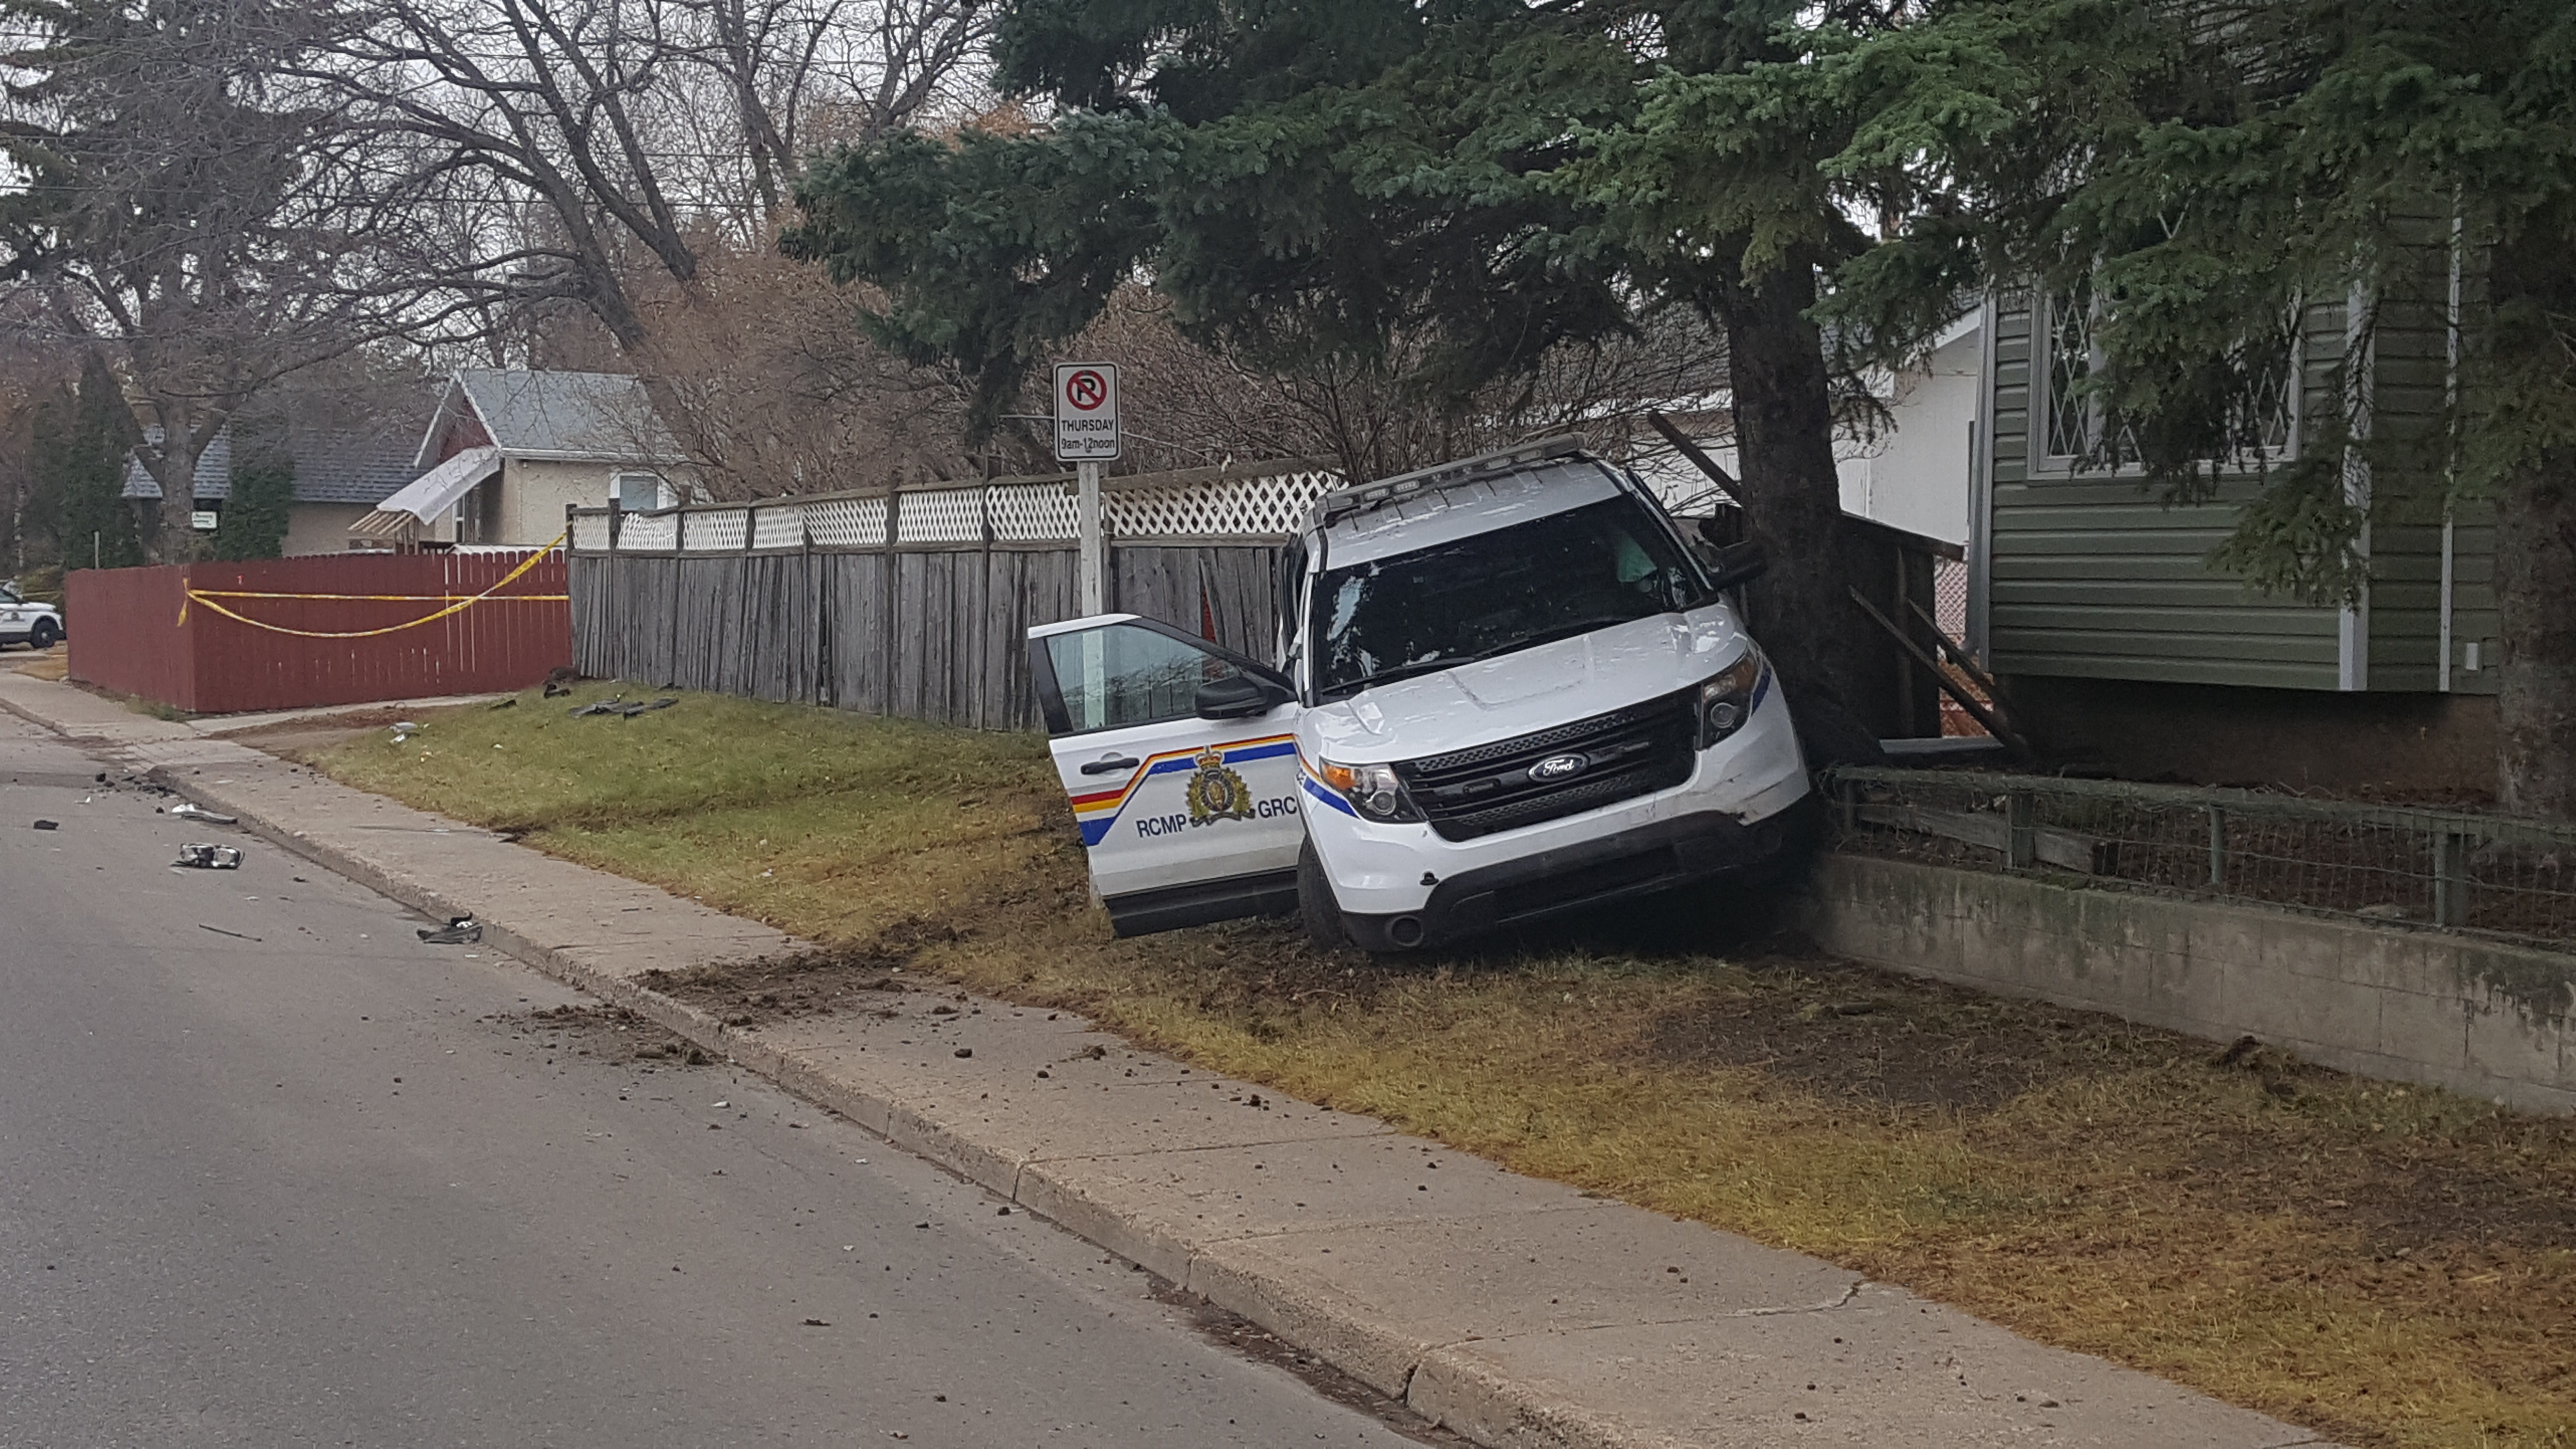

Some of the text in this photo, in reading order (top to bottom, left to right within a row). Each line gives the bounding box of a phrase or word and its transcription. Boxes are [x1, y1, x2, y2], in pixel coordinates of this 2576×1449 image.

[1062, 419, 1114, 432] THURSDAY
[1061, 437, 1115, 449] 9am-12noon
[1543, 759, 1575, 775] Ford
[1136, 814, 1187, 837] RCMP
[1258, 796, 1297, 818] GRC
